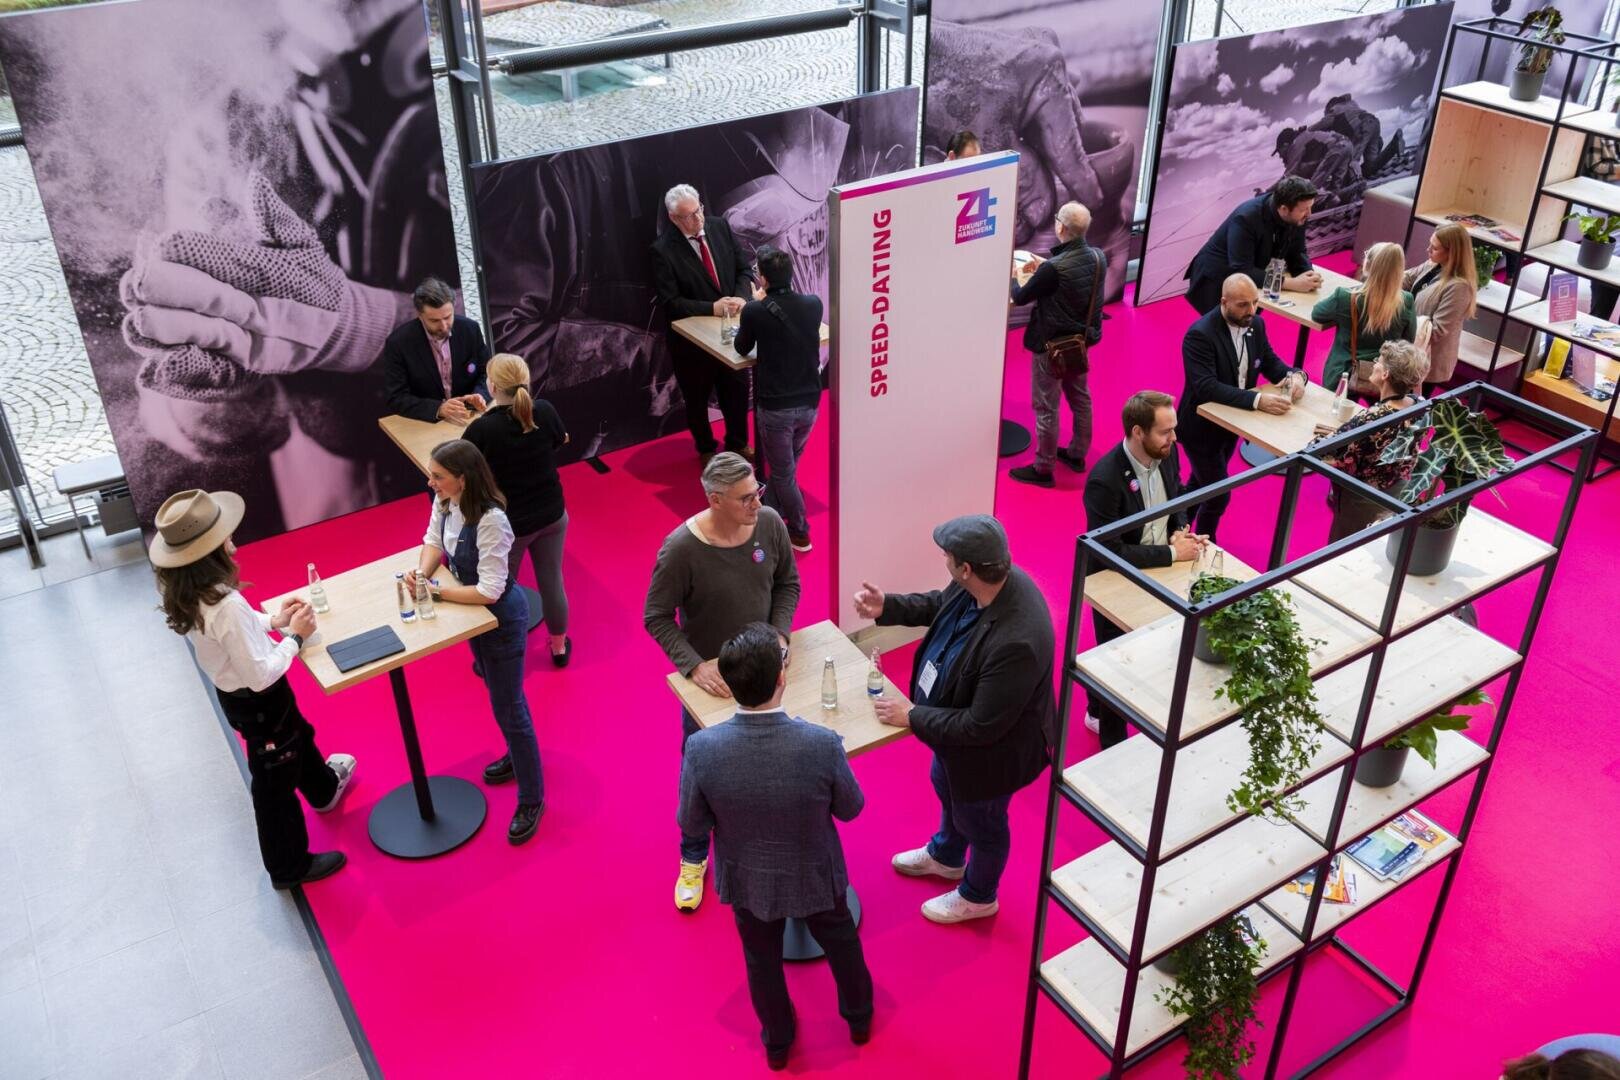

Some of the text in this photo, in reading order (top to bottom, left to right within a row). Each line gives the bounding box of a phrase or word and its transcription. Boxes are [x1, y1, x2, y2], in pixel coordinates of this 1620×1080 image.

[957, 224, 993, 239] HANDWERK
[958, 219, 987, 233] ZUKUNFT
[871, 208, 892, 398] SPEED-DATING
